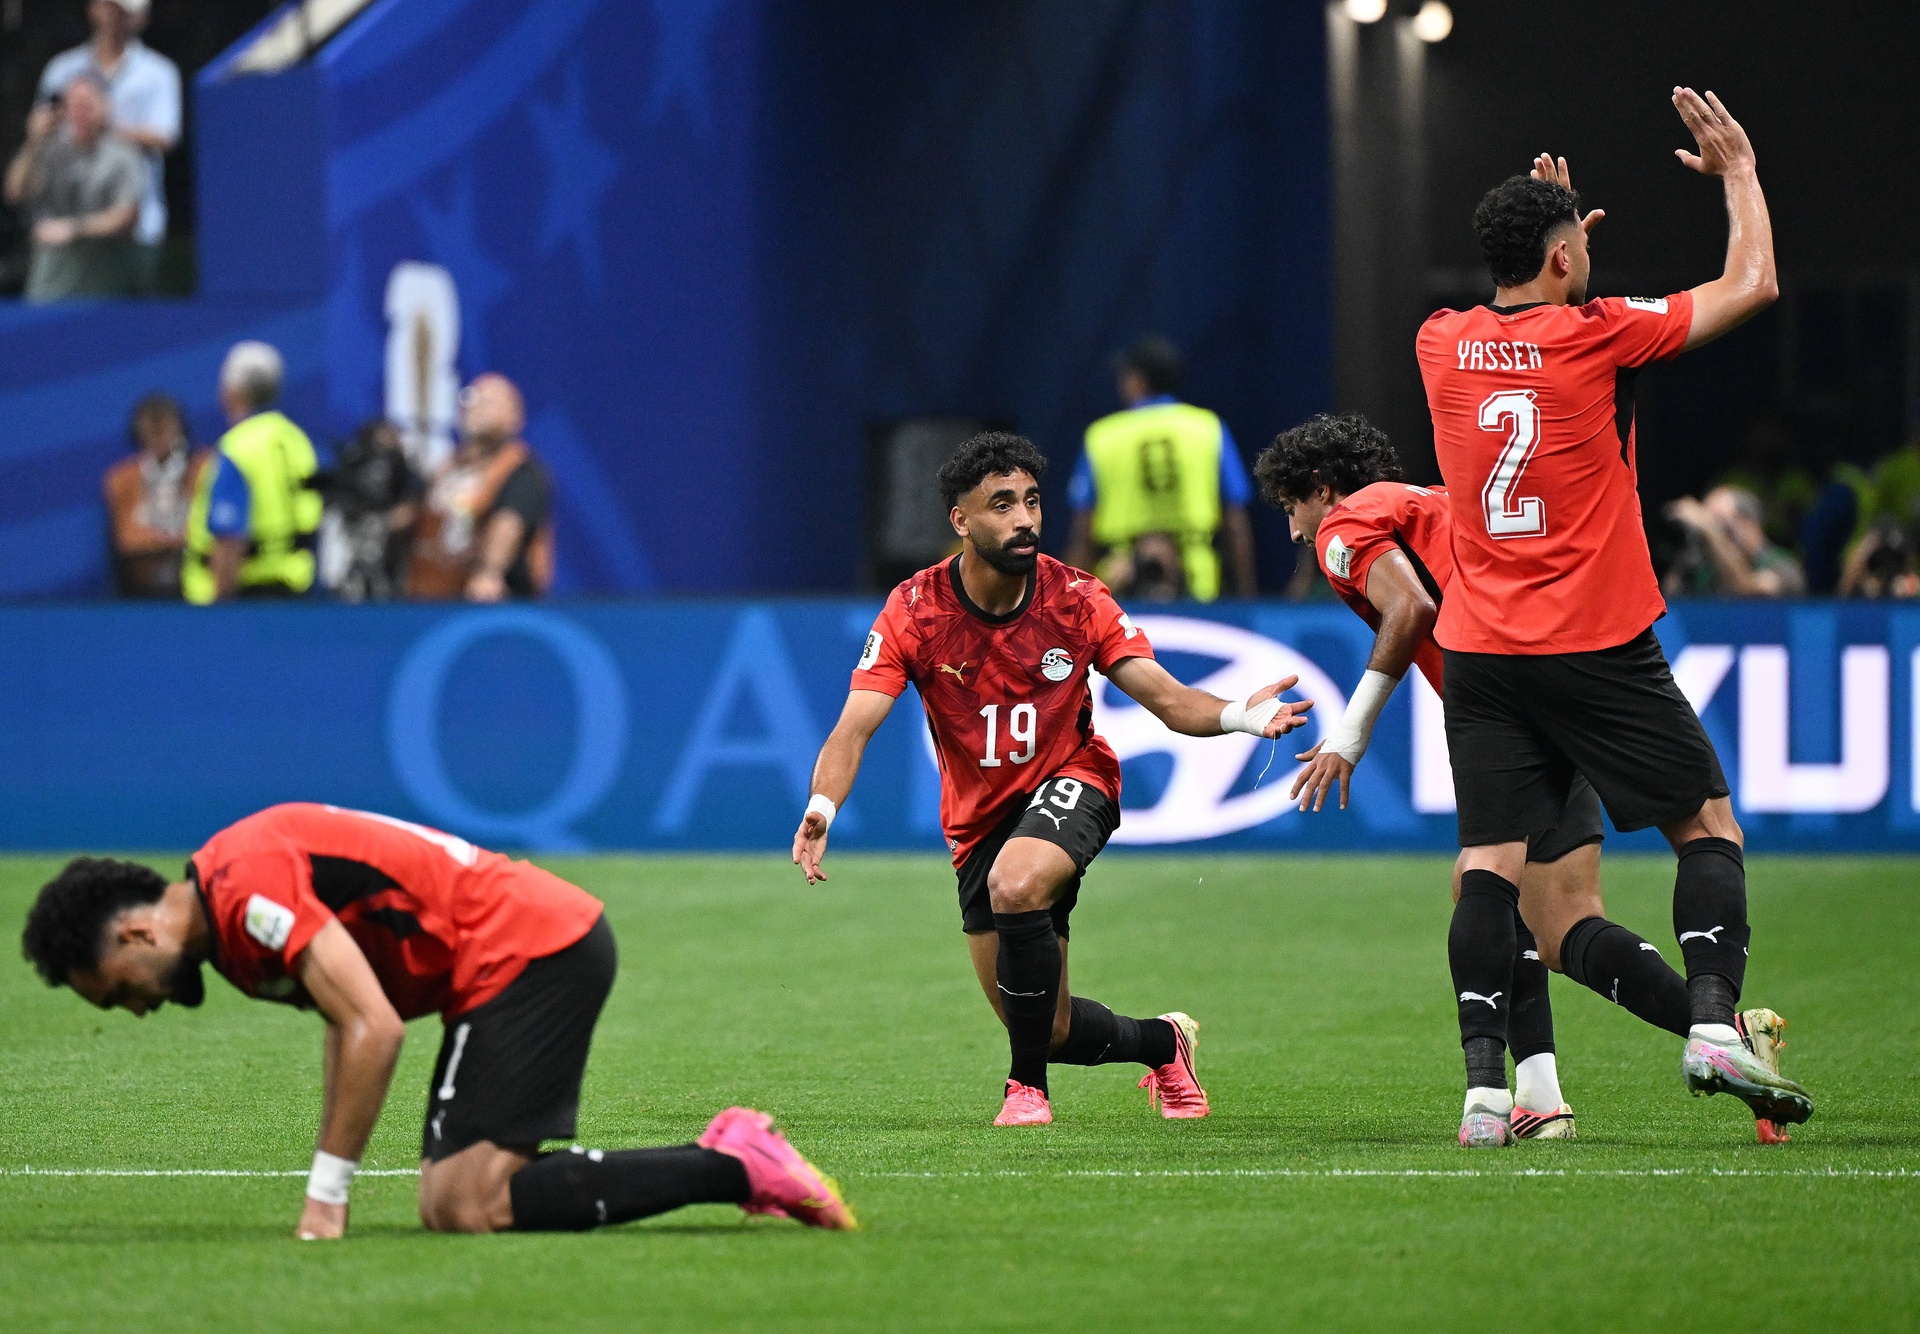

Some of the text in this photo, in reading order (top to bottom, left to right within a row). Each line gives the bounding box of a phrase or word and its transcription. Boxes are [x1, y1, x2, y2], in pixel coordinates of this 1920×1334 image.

[1457, 340, 1543, 370] YASSER
[1478, 389, 1546, 540] 2
[979, 703, 1037, 767] 19
[1025, 778, 1084, 811] 19
